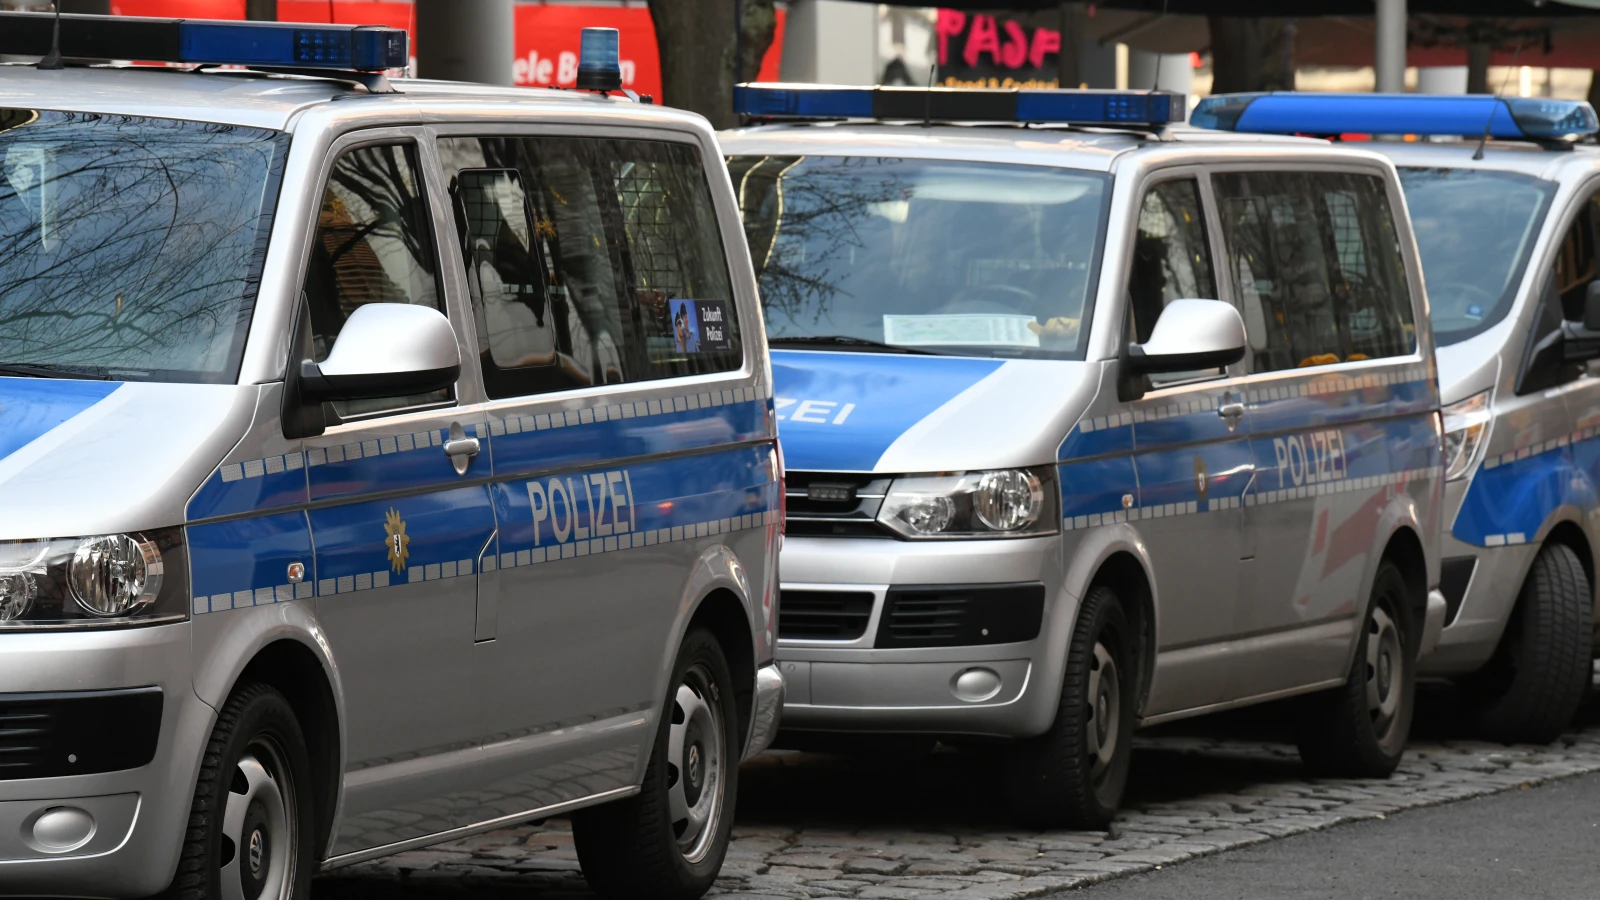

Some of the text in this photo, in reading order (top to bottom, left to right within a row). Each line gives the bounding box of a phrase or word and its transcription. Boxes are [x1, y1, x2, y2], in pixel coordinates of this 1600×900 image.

[701, 306, 722, 322] Zukunft
[706, 326, 724, 341] Polizei
[1273, 429, 1347, 488] POLIZEI
[526, 469, 636, 547] POLIZEI
